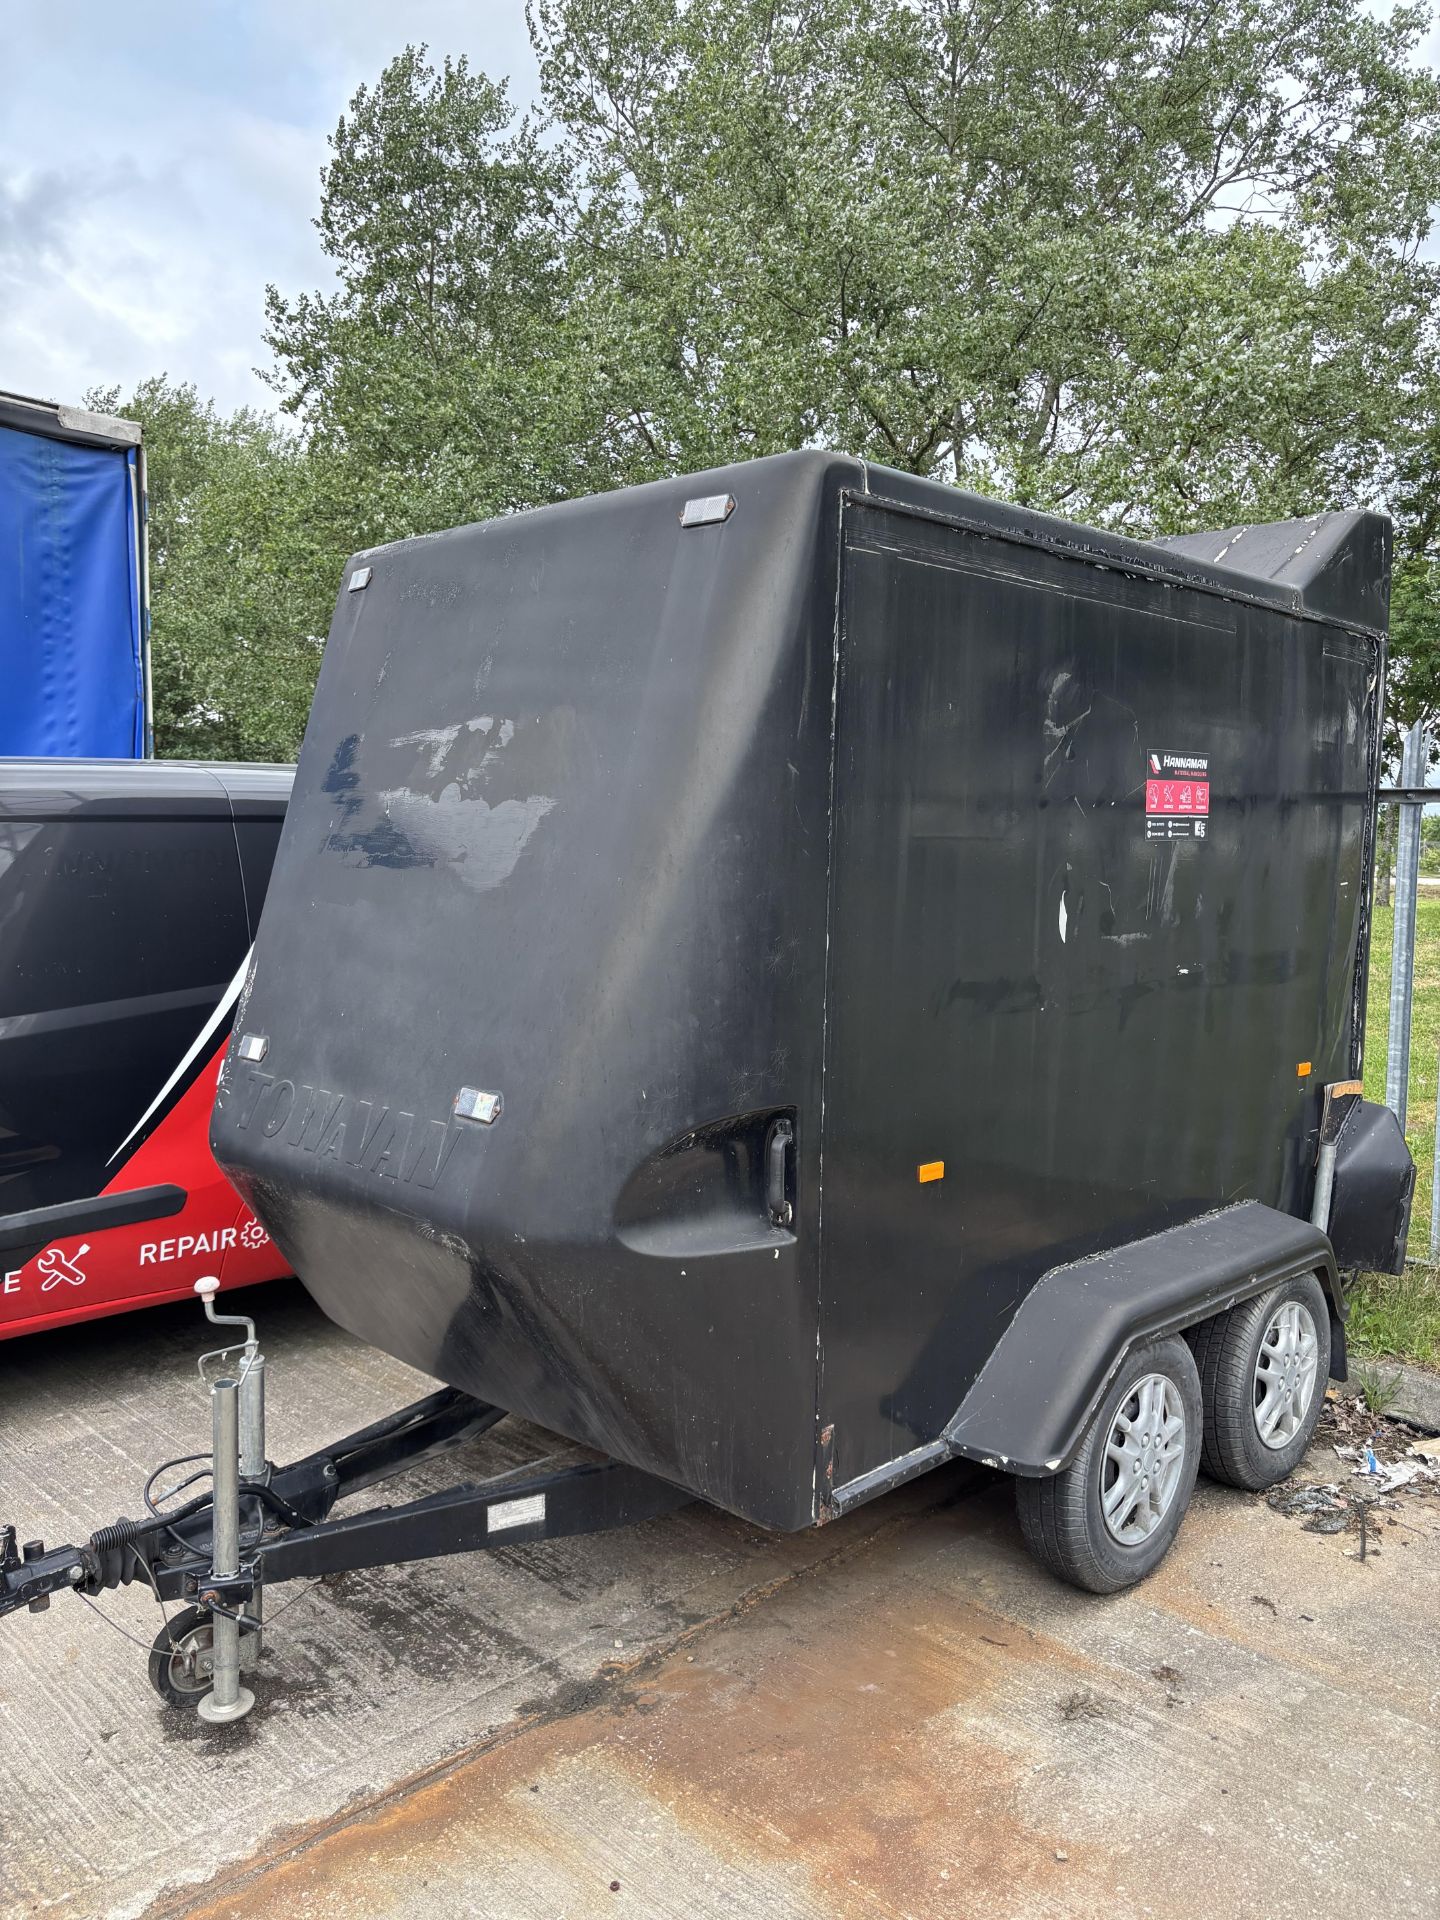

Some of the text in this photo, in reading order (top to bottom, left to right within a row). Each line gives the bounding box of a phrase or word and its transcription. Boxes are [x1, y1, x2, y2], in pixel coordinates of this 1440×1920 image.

[1163, 755, 1208, 770] HANNAMAN
[236, 1070, 465, 1190] TOWAVAN
[139, 1227, 237, 1266] REPAIR
